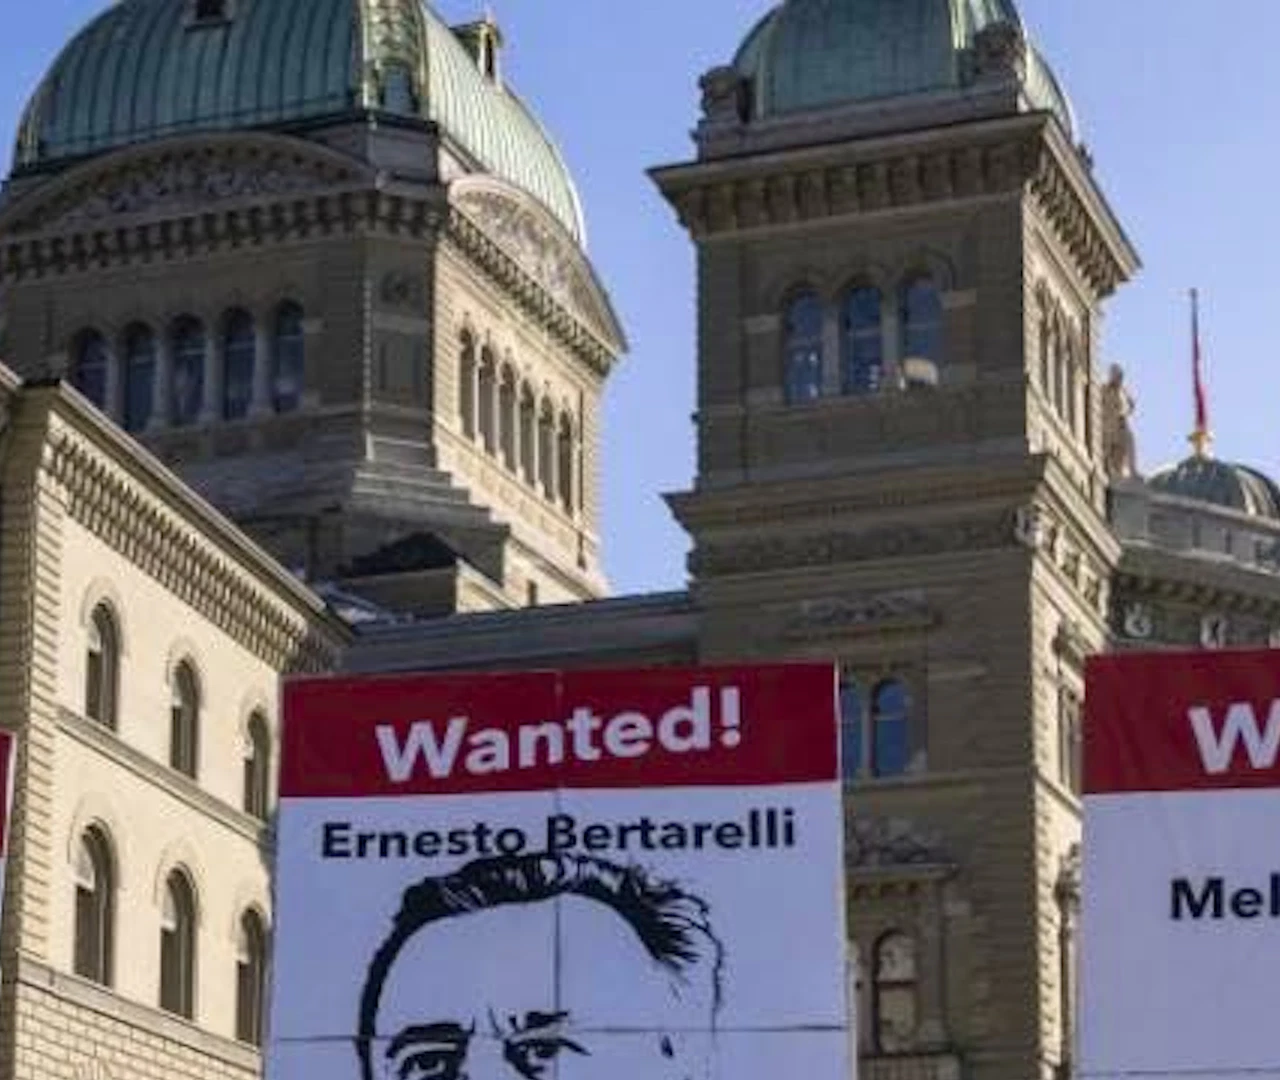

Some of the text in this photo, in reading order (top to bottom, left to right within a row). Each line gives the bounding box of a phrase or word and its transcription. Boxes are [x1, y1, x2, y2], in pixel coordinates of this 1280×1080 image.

[375, 686, 742, 782] Wanted!
[321, 808, 796, 859] Ernesto Bertarelli
